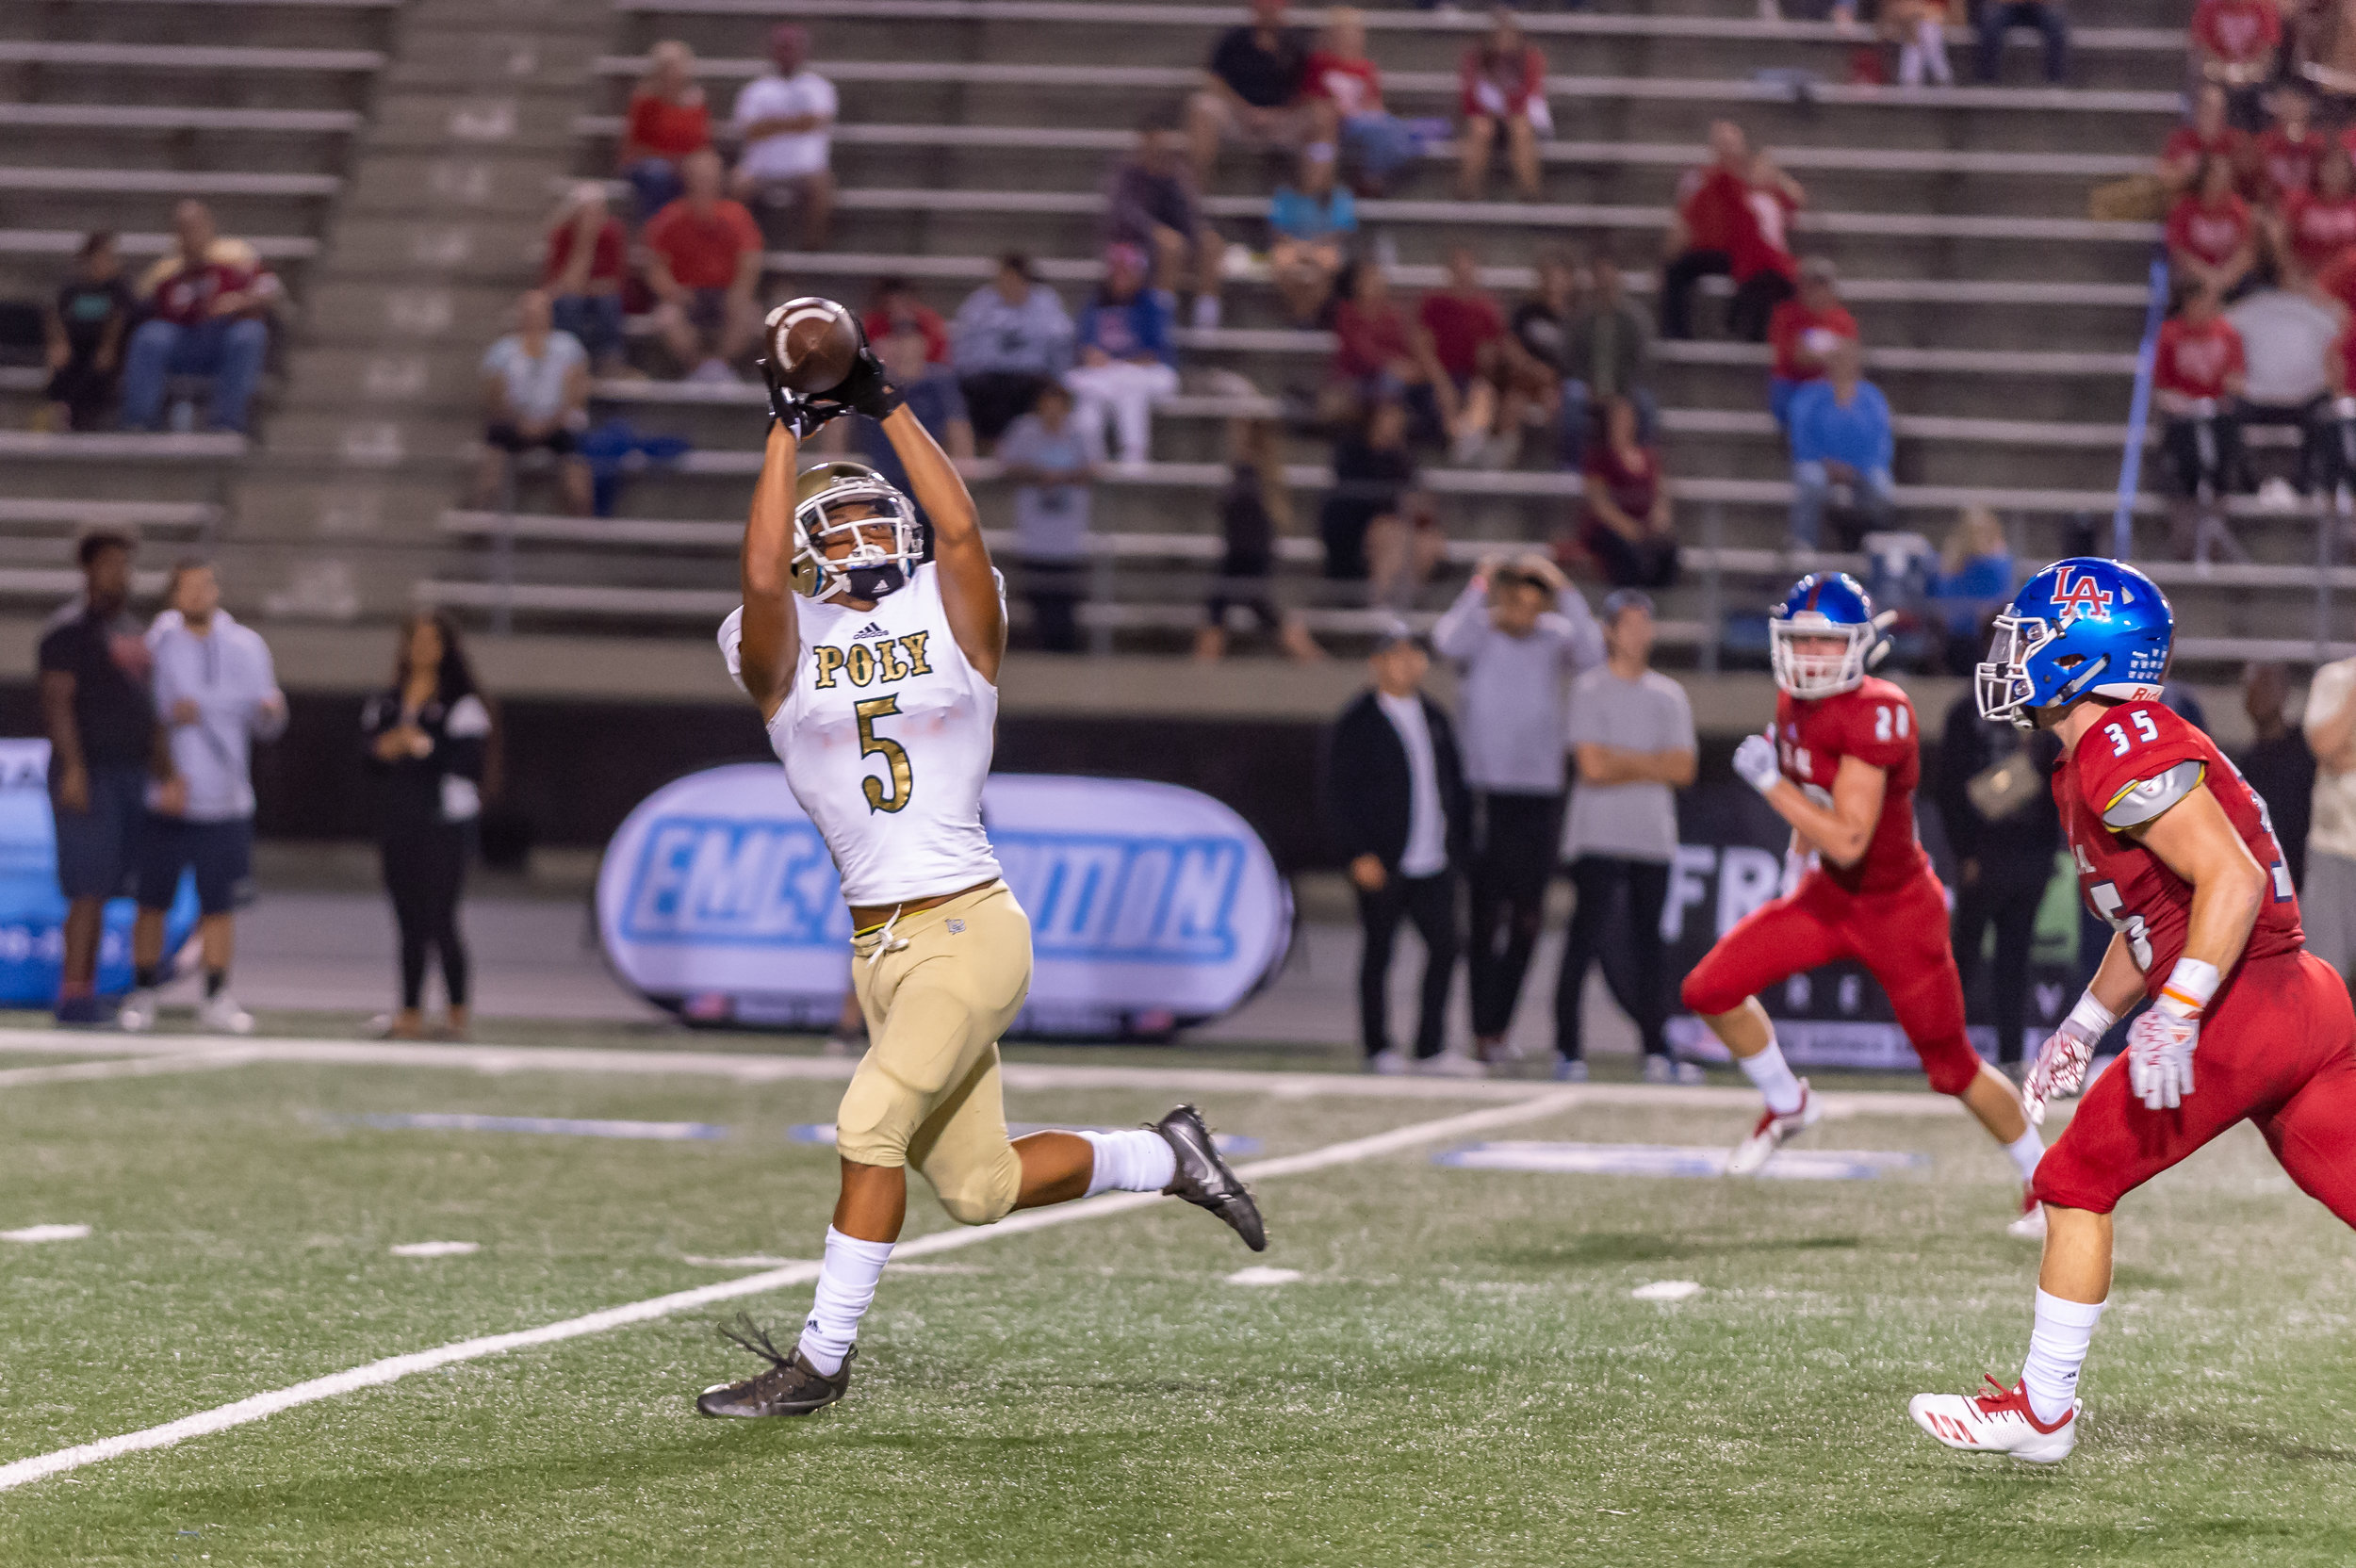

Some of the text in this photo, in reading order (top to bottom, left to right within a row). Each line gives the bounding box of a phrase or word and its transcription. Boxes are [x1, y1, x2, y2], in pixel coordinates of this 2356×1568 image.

[2050, 566, 2114, 619] LA
[813, 629, 934, 690] POLY
[853, 629, 890, 640] adidas
[854, 693, 913, 815] 5
[2103, 710, 2159, 758] 35
